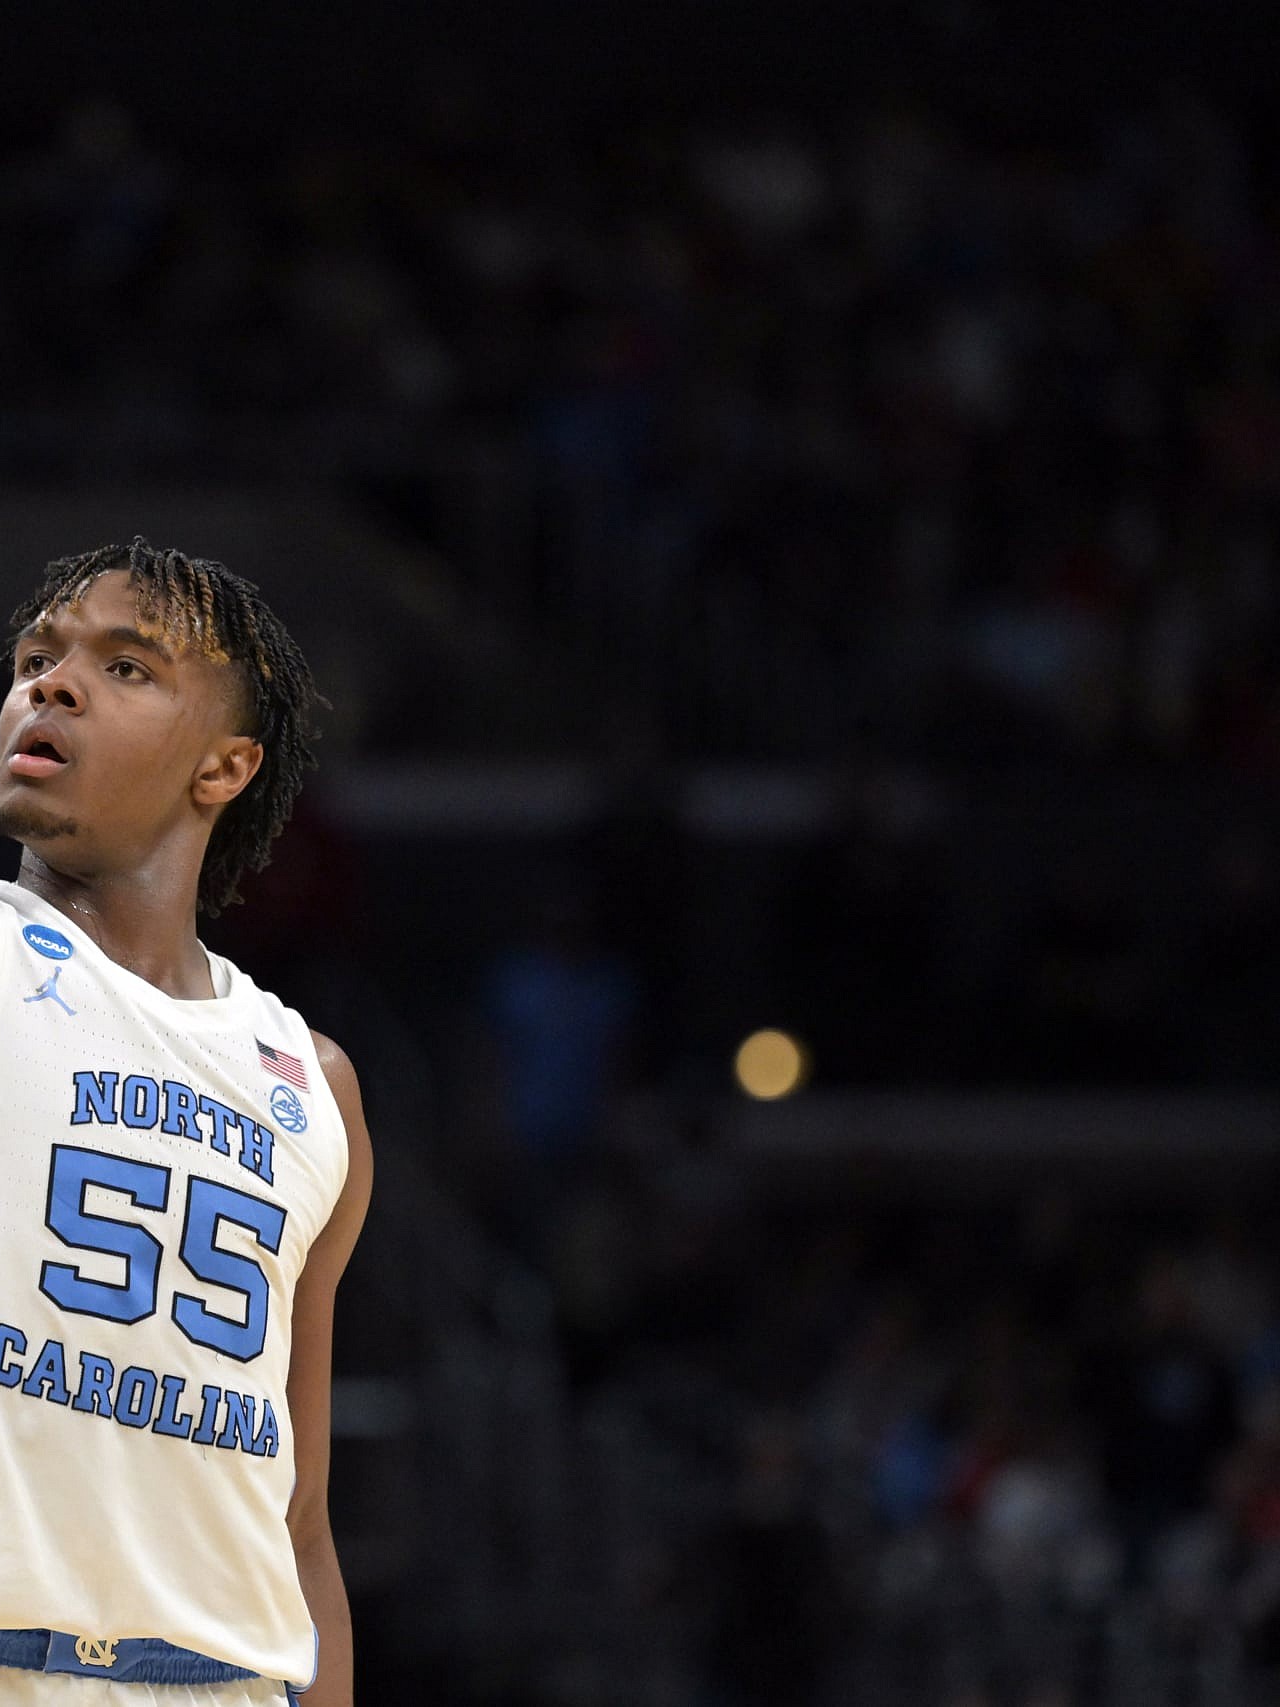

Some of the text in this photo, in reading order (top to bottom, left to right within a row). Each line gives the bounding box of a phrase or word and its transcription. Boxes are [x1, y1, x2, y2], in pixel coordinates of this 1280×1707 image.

[29, 933, 70, 956] NCAA
[70, 1071, 274, 1187] NORTH
[39, 1143, 287, 1363] 55
